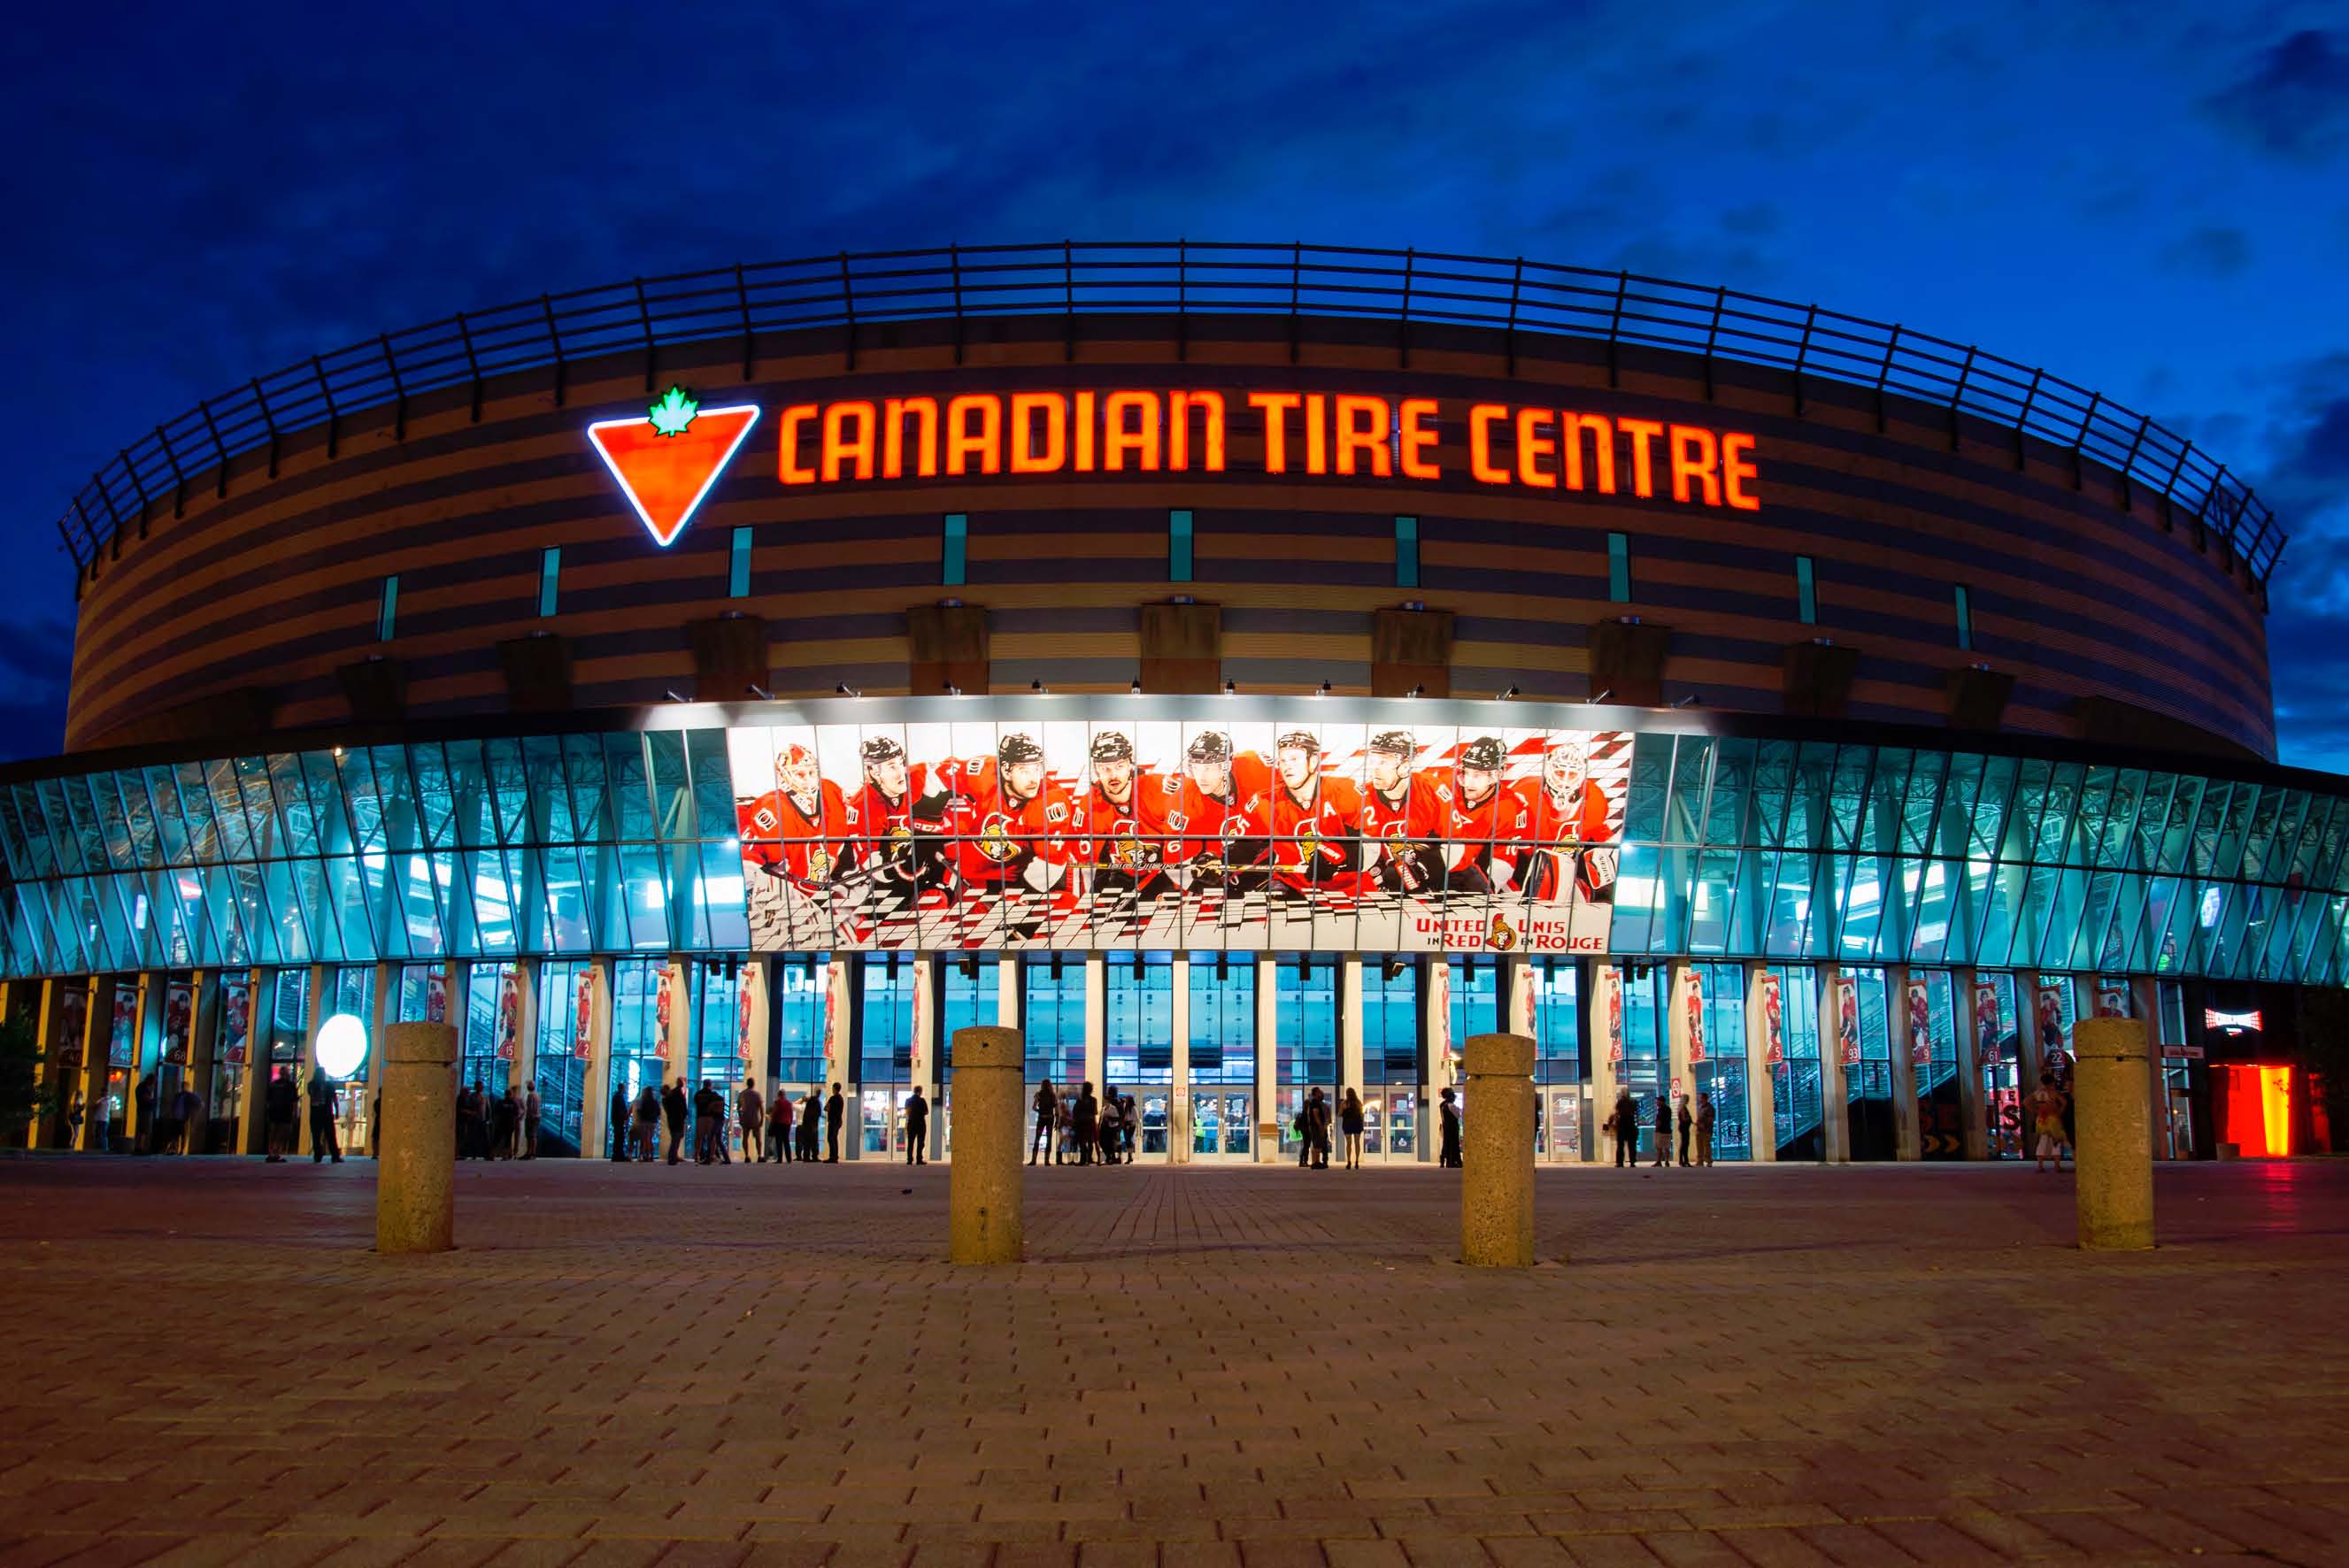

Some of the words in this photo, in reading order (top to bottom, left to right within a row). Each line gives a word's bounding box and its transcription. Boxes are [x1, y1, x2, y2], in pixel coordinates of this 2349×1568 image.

[778, 391, 1225, 484] CANADIAN
[1248, 392, 1440, 478] TIRE
[1469, 404, 1760, 511] CENTRE
[1363, 805, 1378, 826] 2
[1416, 919, 1485, 934] UNITED
[1517, 919, 1566, 934] UNIS
[1428, 937, 1440, 946] IN
[1443, 934, 1482, 948] RED
[1535, 934, 1604, 950] ROUGE
[1848, 1047, 1859, 1059] 93
[1988, 1049, 1999, 1061] 61
[2052, 1052, 2063, 1063] 22
